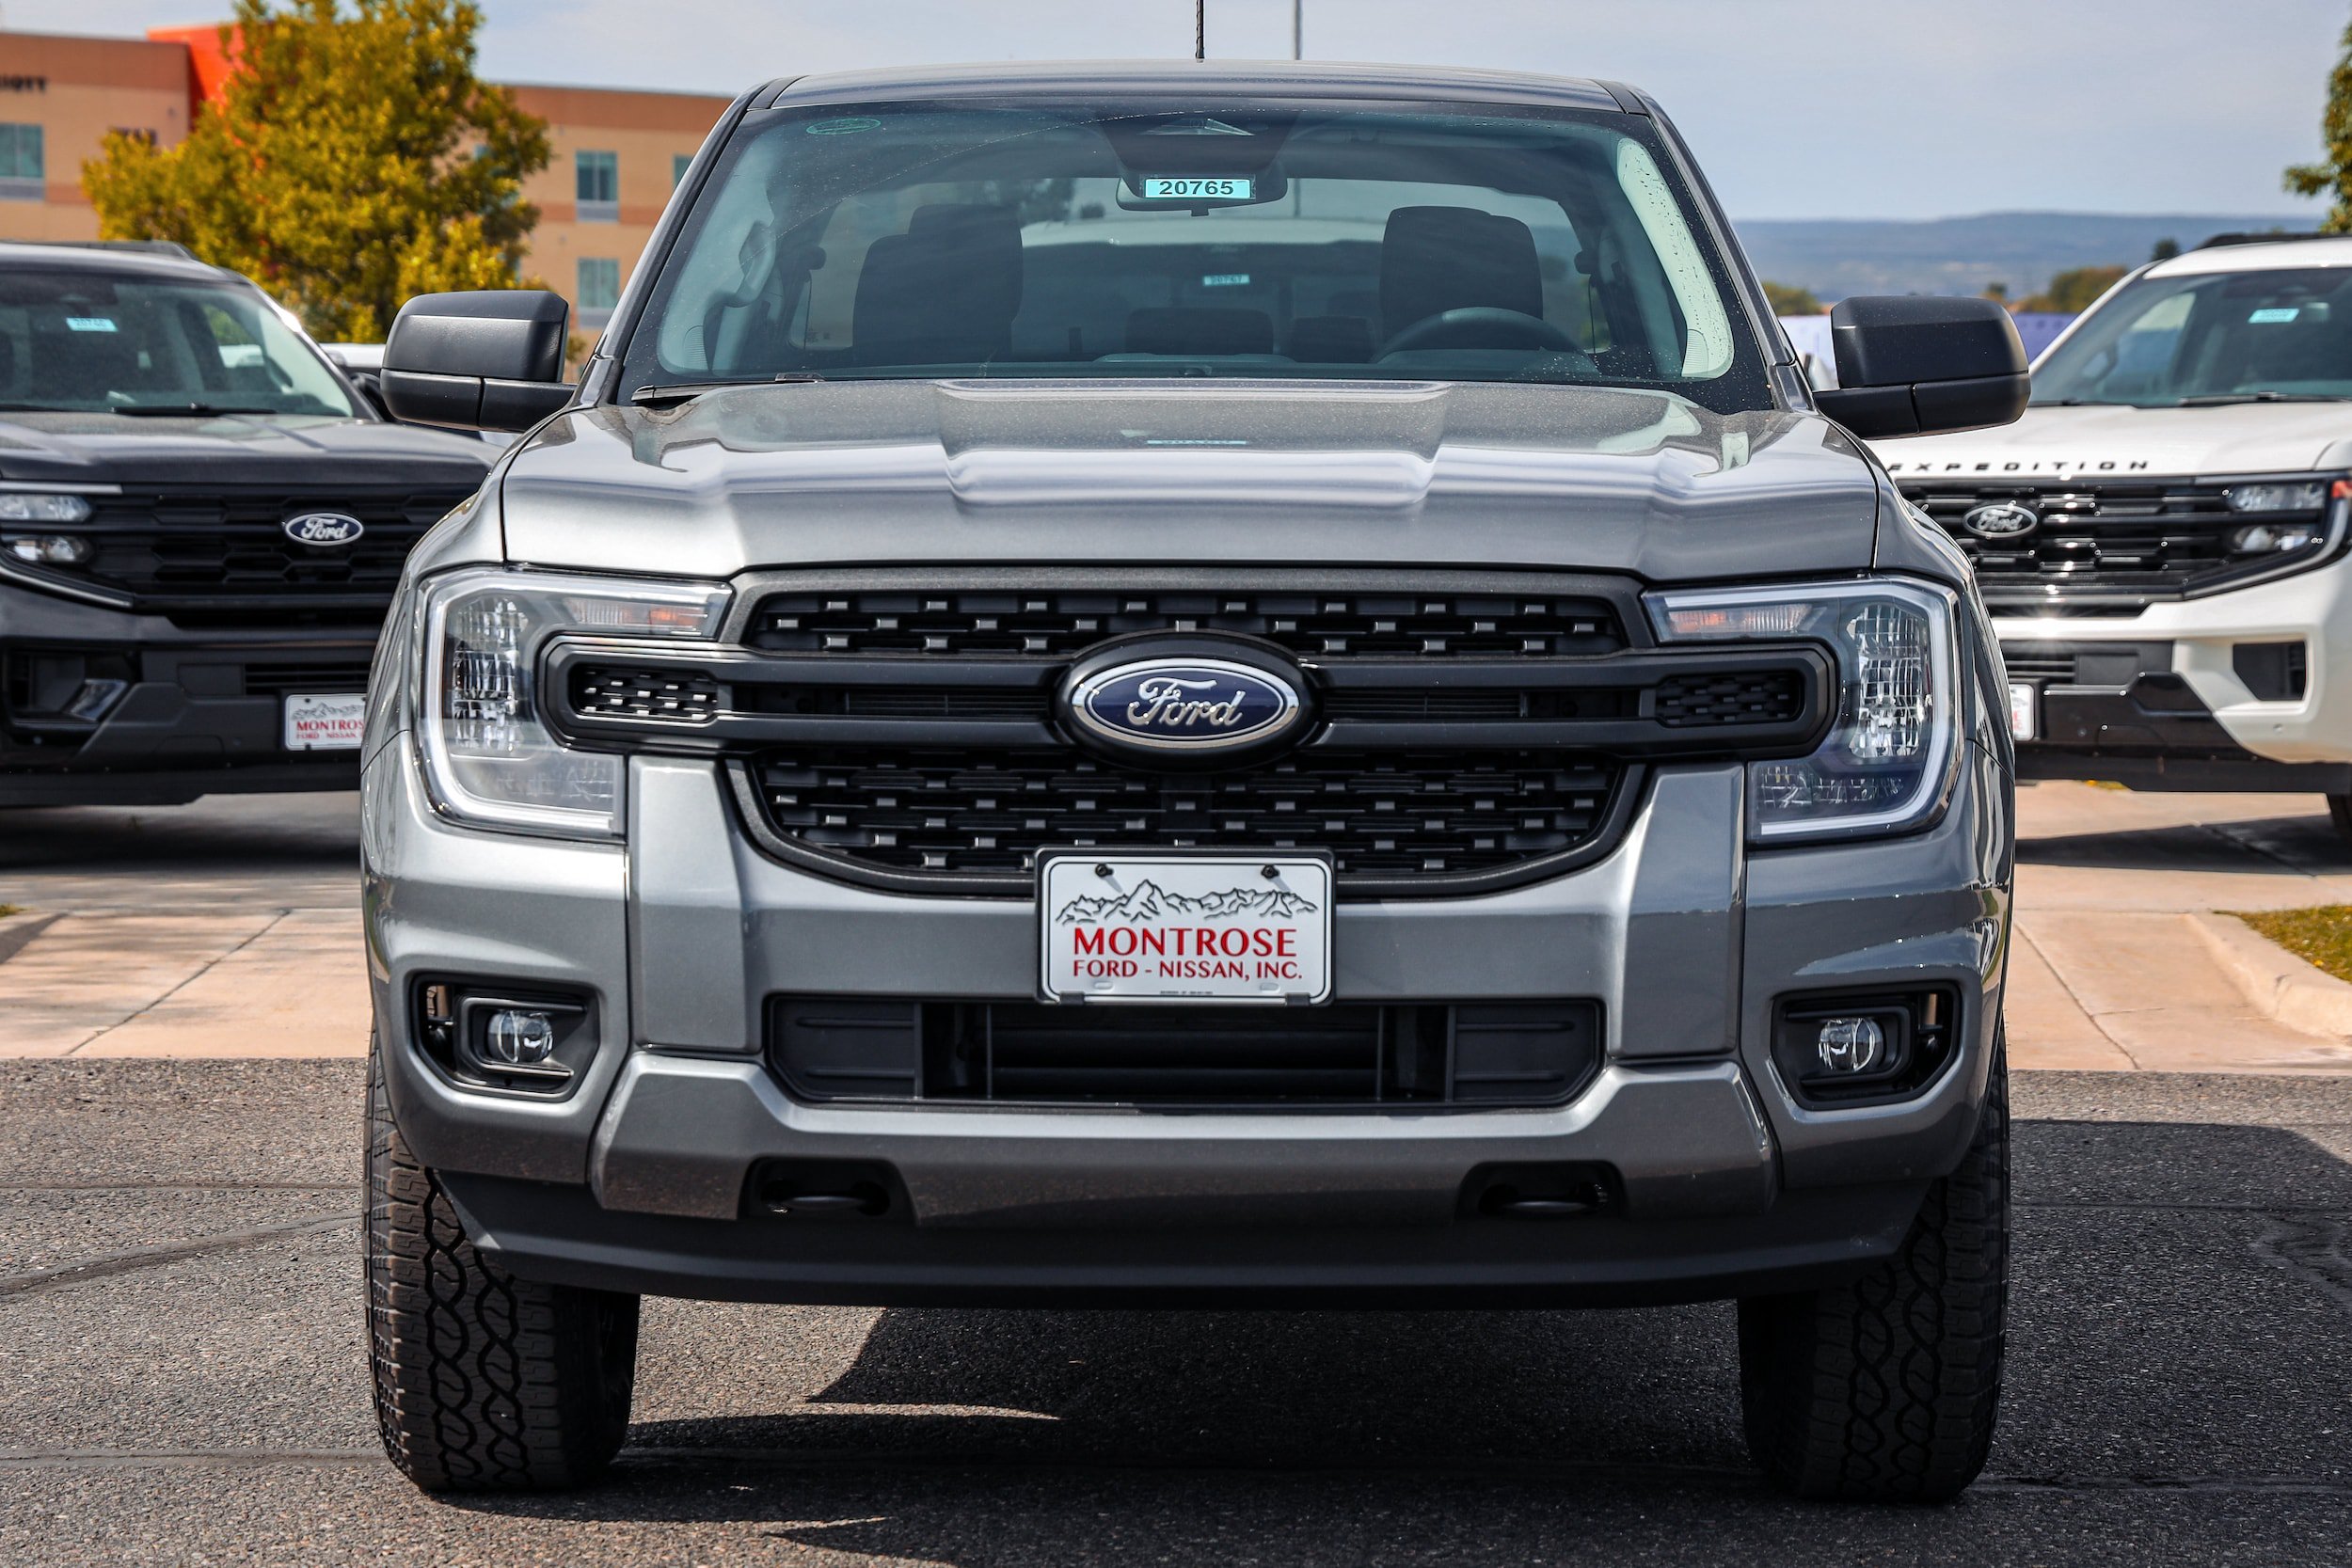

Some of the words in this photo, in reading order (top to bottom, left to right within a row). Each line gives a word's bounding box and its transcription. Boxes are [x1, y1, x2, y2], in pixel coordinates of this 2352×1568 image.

[1159, 181, 1234, 195] 20765
[1887, 460, 2149, 472] EXPEDITION
[301, 517, 349, 540] Ford
[1977, 509, 2024, 531] Ford
[1127, 677, 1246, 726] Ford
[1073, 927, 1297, 957] MONTROSE
[1073, 959, 1138, 977] FORD
[1159, 960, 1250, 982] NISSAN,
[1257, 960, 1303, 979] INC.
